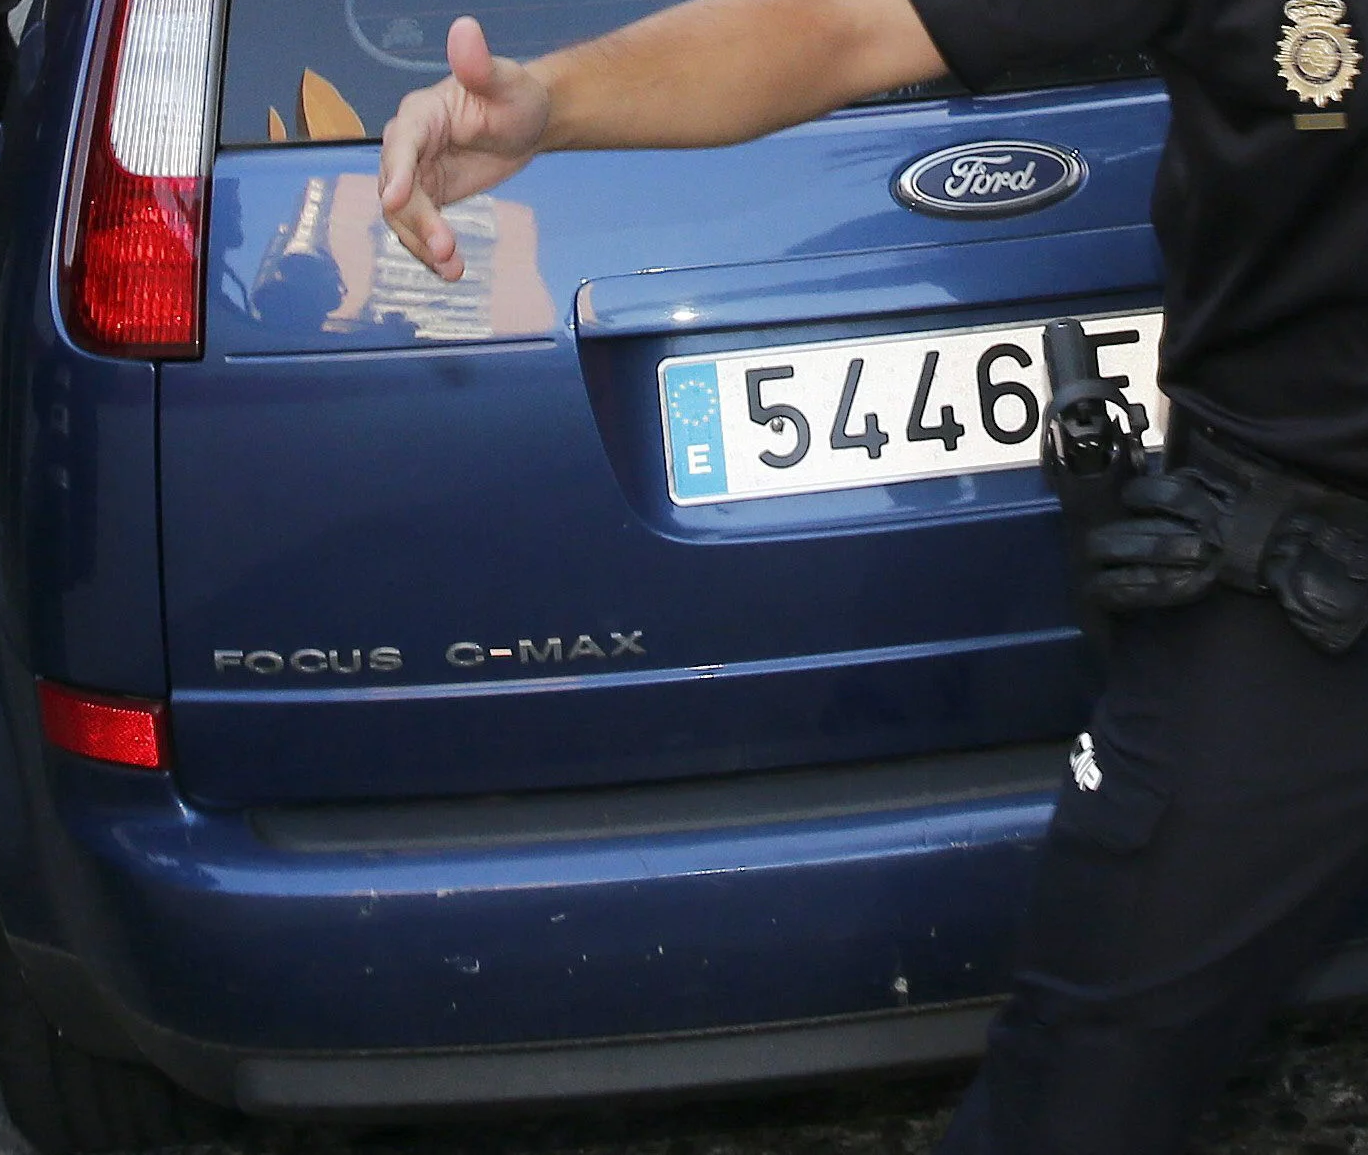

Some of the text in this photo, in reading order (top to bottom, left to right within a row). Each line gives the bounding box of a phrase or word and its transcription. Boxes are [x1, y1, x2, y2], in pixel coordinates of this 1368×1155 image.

[944, 154, 1037, 198] Ford
[745, 343, 1040, 469] 5446
[687, 443, 711, 476] E
[214, 629, 648, 675] FOCUS C-MAX
